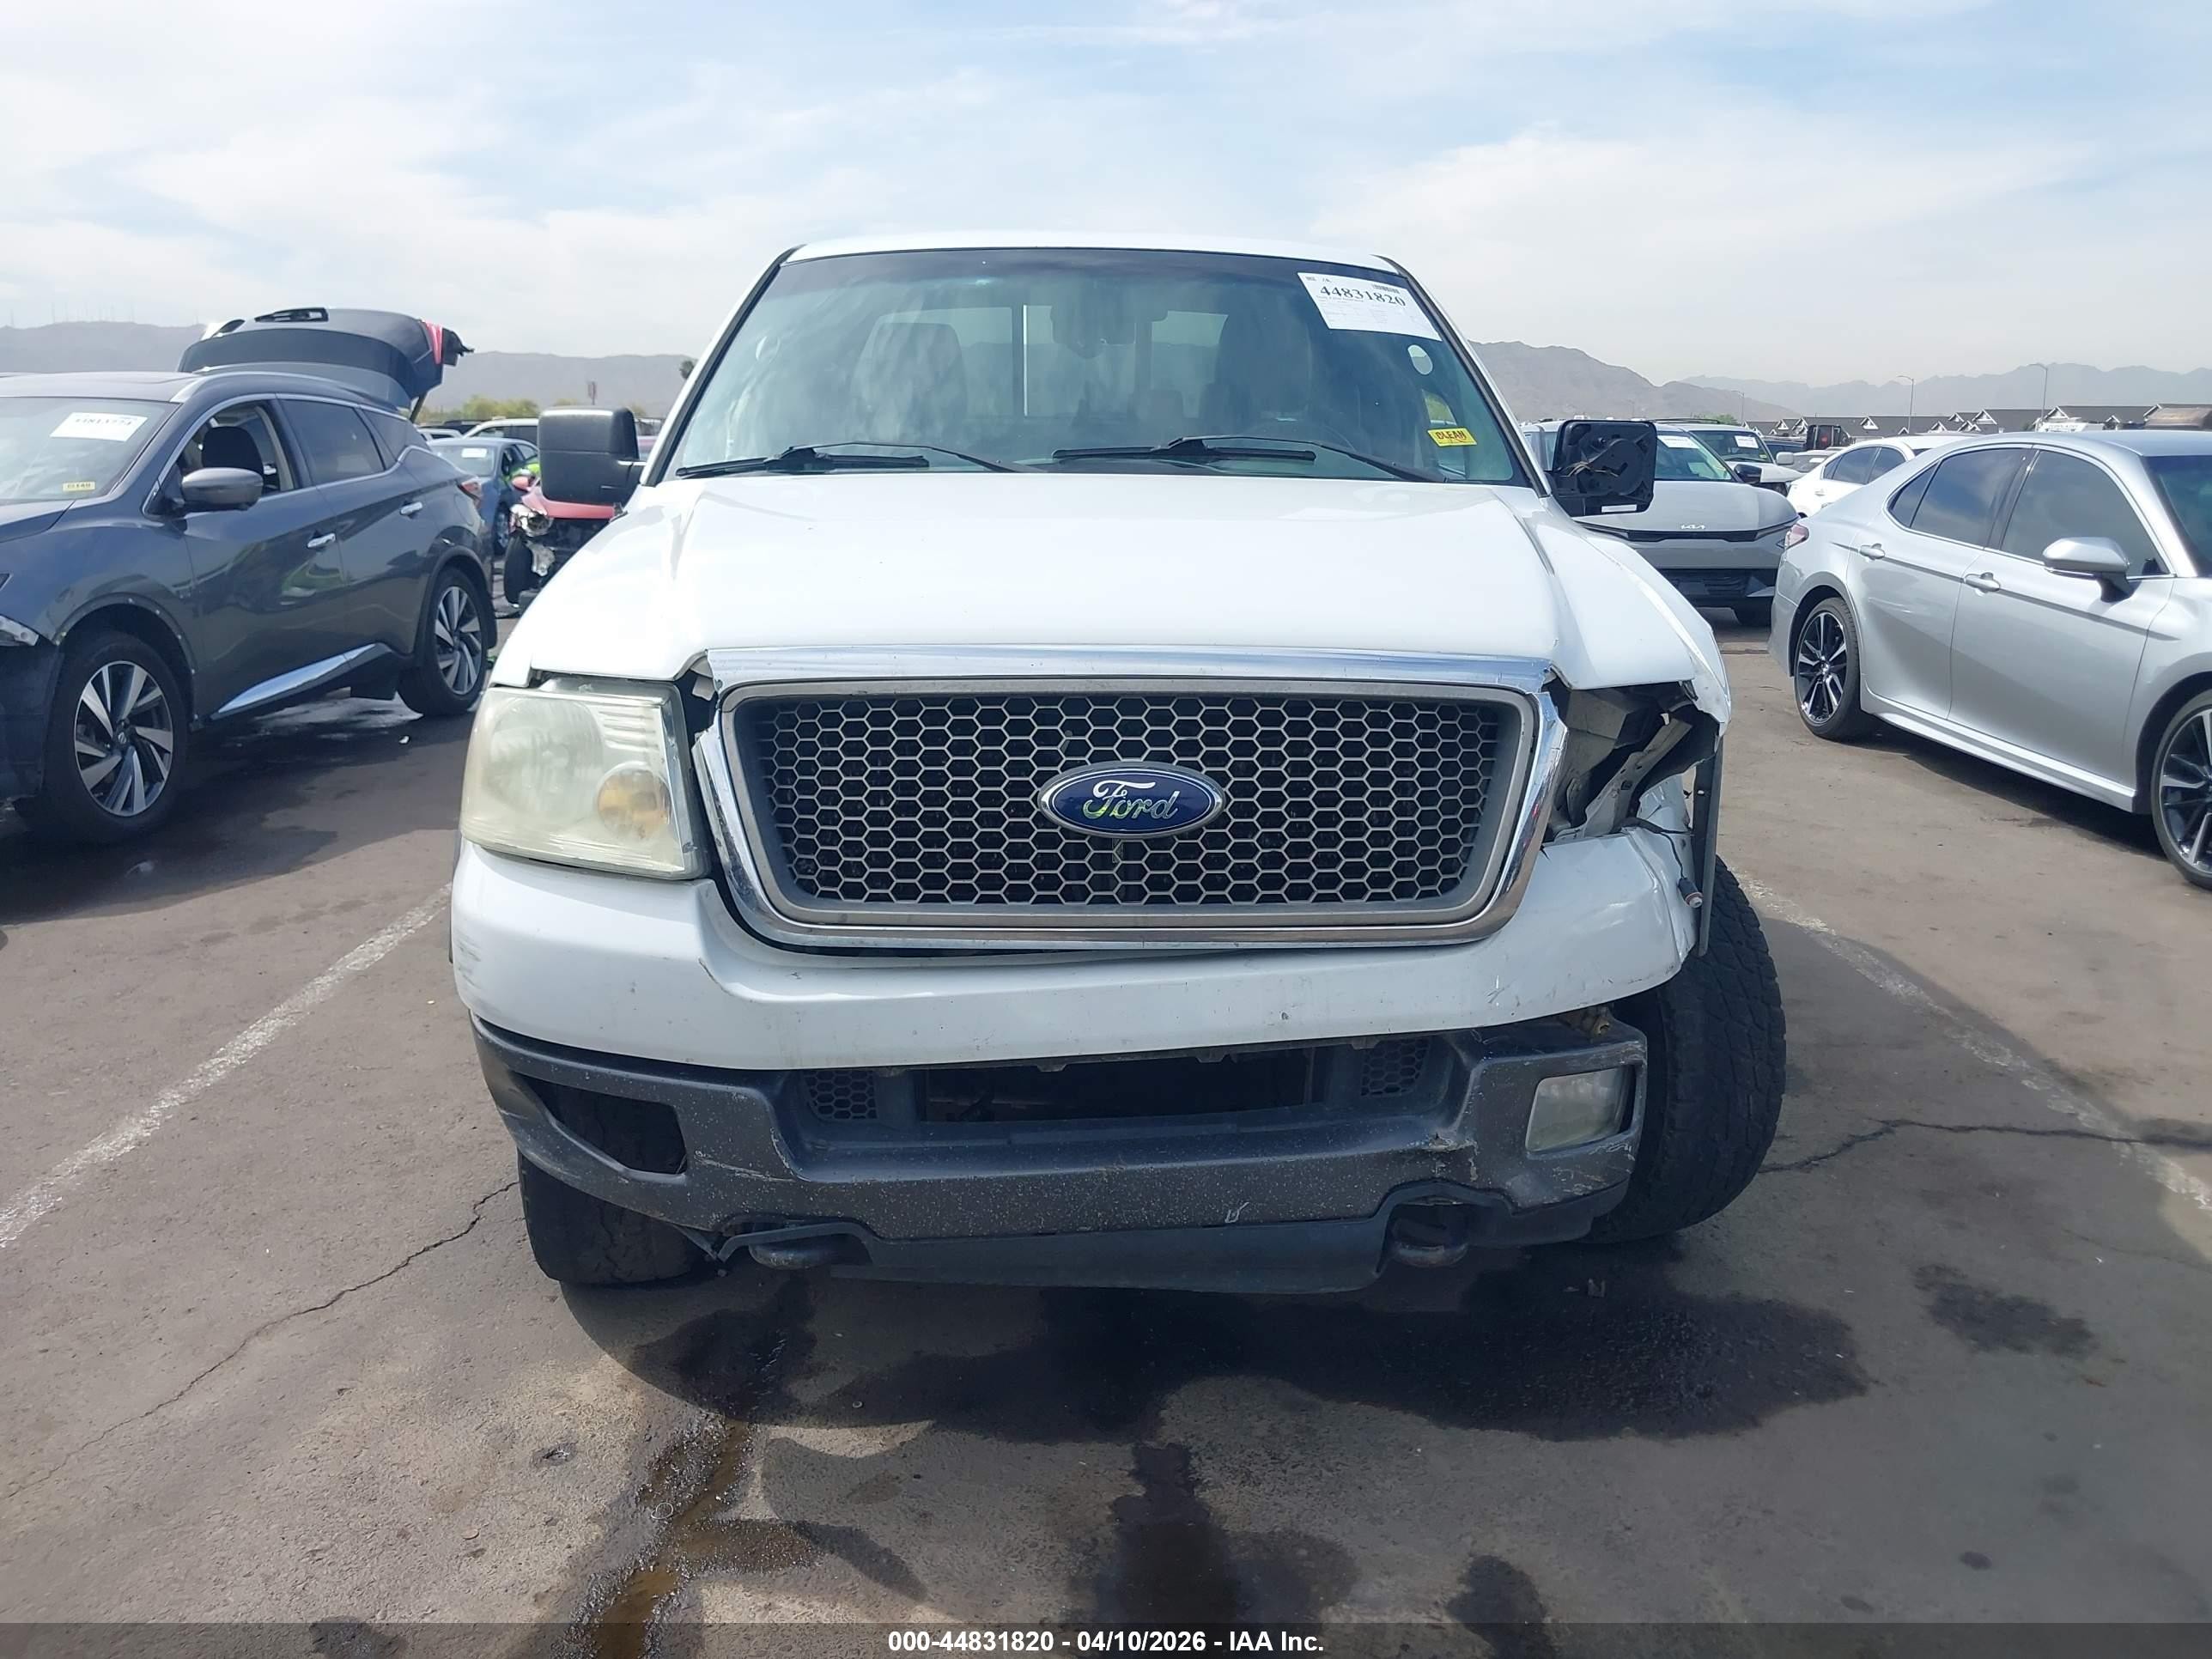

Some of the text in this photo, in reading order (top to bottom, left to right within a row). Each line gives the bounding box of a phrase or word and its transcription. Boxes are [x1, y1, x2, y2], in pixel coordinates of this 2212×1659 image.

[1320, 285, 1406, 307] 44831820
[1435, 430, 1467, 441] CLEAN
[1082, 780, 1181, 819] Ford
